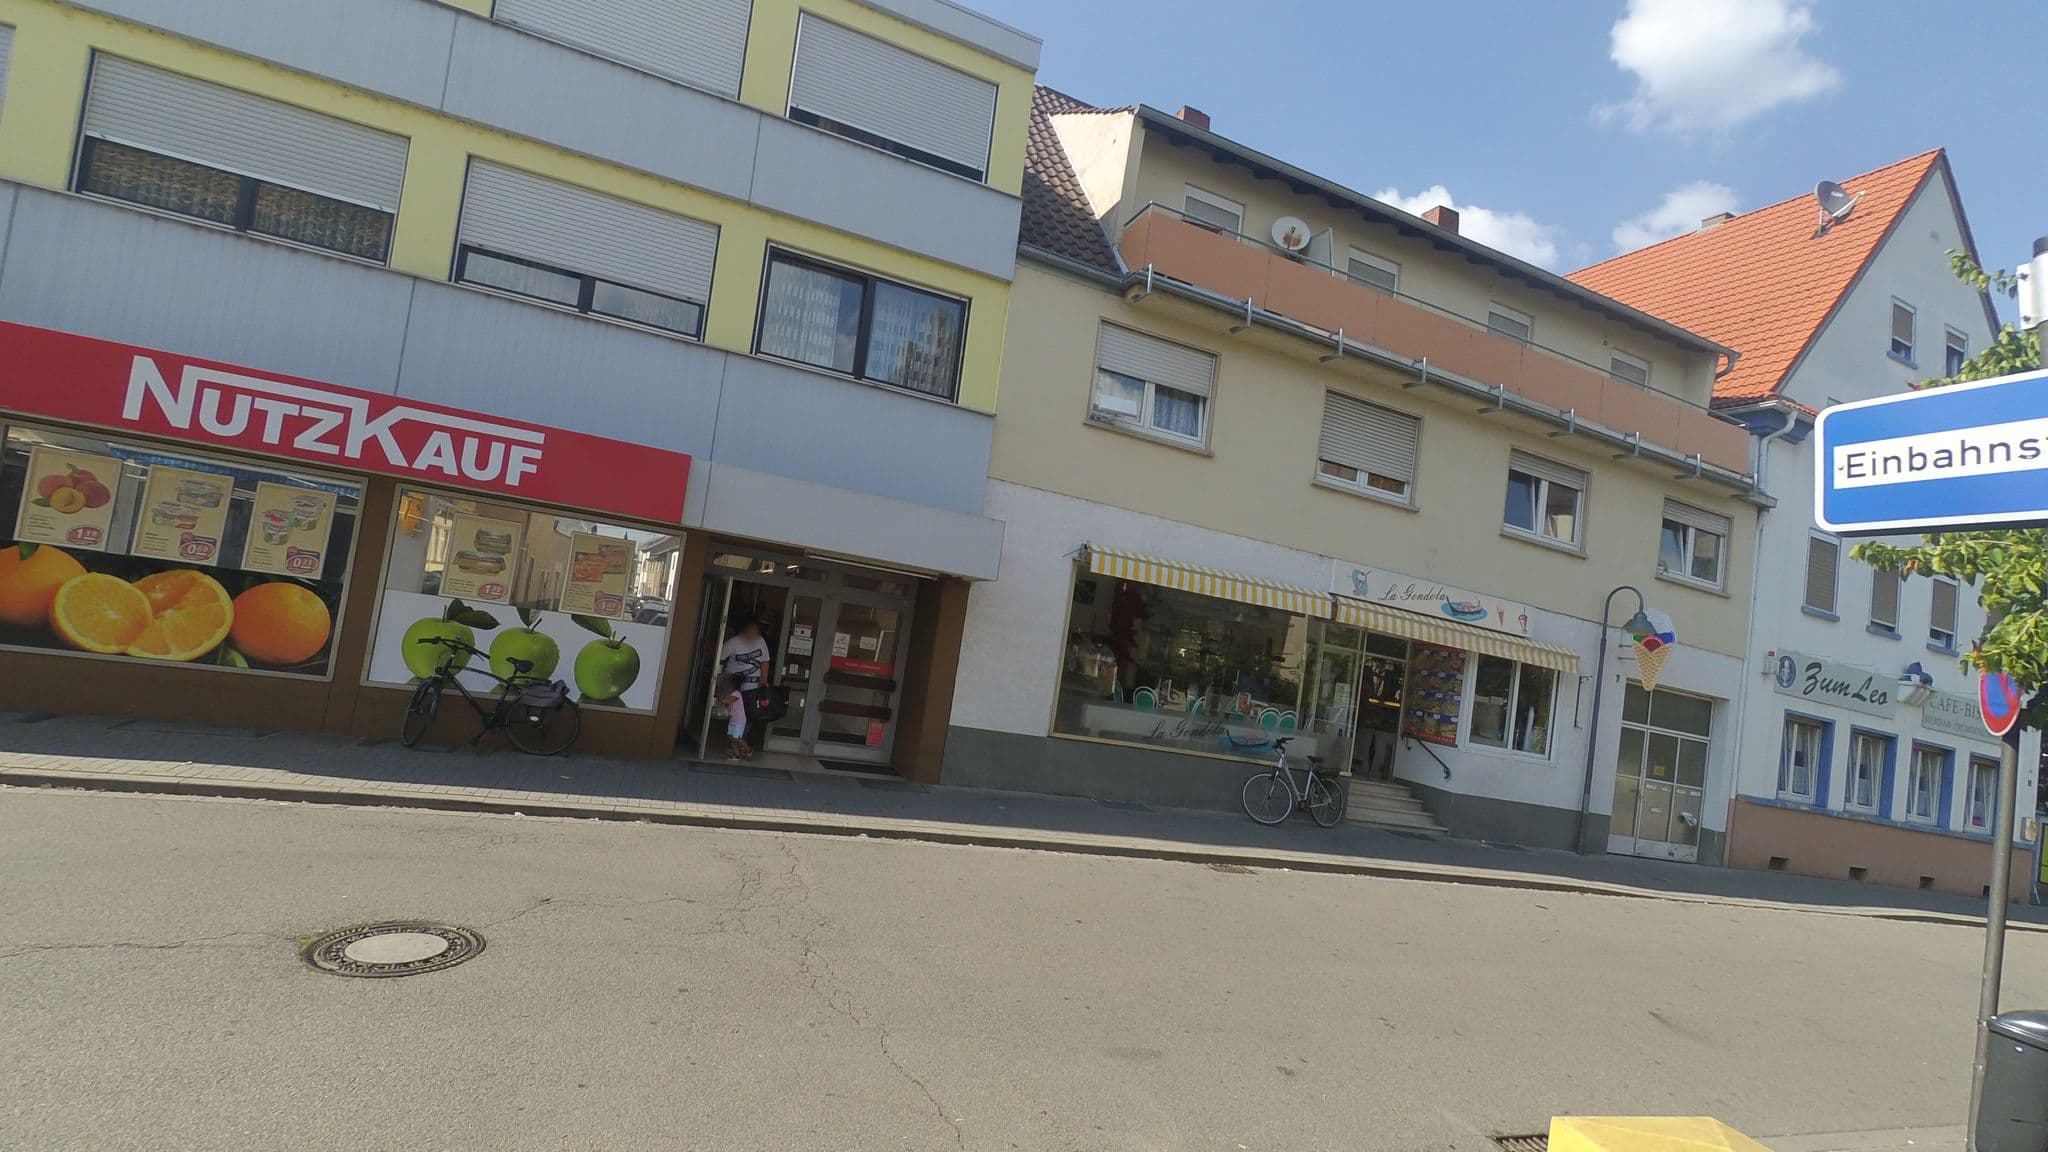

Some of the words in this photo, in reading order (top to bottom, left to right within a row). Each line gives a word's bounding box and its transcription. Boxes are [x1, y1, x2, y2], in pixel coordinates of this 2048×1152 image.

[121, 354, 546, 487] NUTZKAUF
[1846, 438, 2048, 479] Einbahns
[1378, 583, 1398, 601] La
[1400, 583, 1447, 601] Gondola
[1802, 661, 1851, 696] Zum
[1850, 675, 1889, 706] Leo
